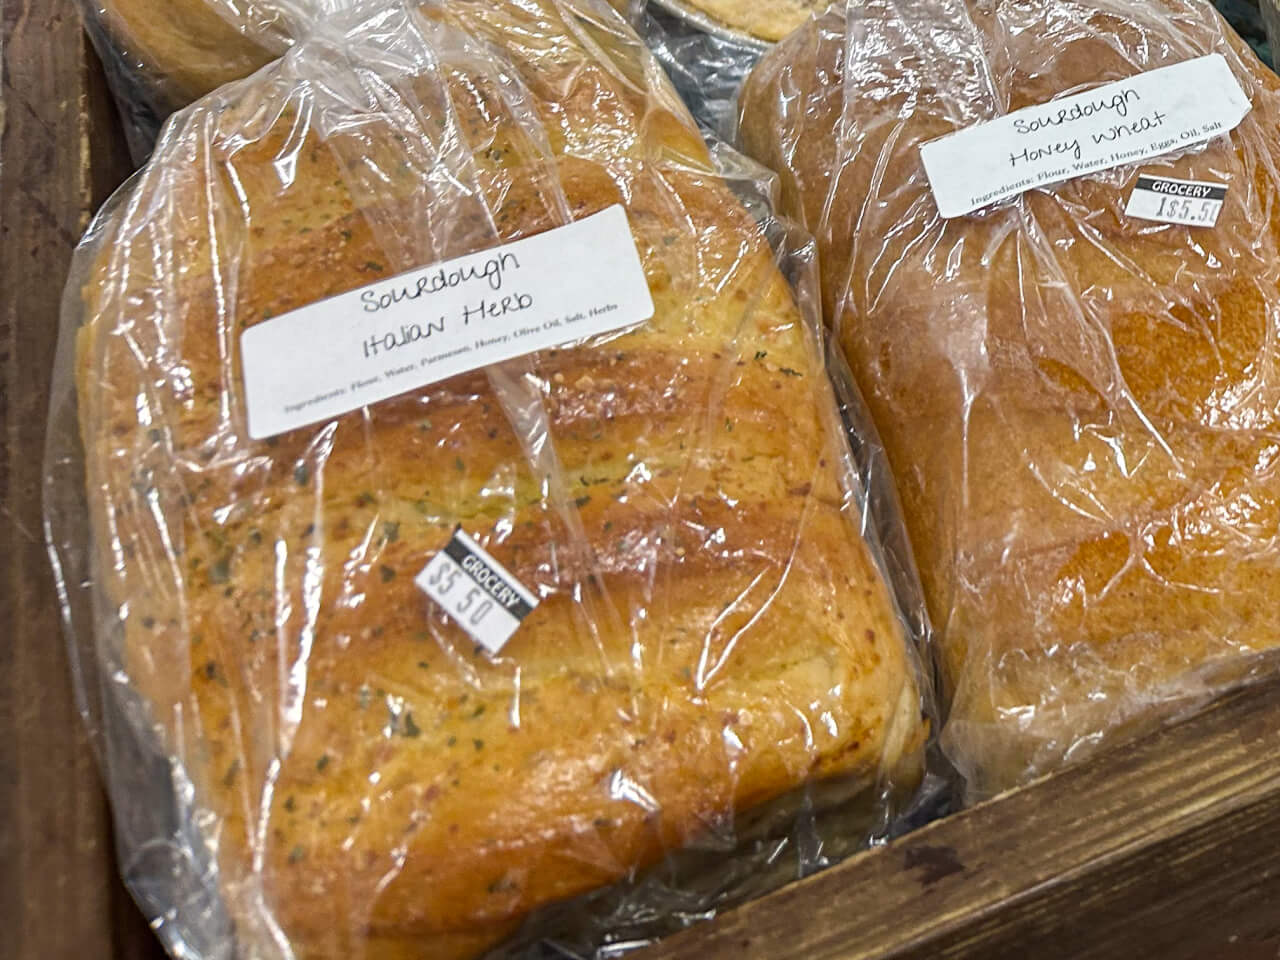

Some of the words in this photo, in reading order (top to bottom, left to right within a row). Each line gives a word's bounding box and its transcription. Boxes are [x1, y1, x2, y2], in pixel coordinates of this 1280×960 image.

[1013, 88, 1141, 136] Sourdough
[969, 176, 1034, 207] Ingredients:
[1037, 166, 1070, 181] Flour,
[1072, 156, 1108, 172] Water,
[1110, 147, 1149, 163] Honey,
[1150, 137, 1177, 152] Eggs,
[1180, 128, 1201, 141] Oil,
[1202, 121, 1223, 135] Salt
[1009, 140, 1081, 168] Honey
[1151, 180, 1212, 198] GROCERY
[360, 249, 521, 313] Sourdough
[363, 316, 445, 358] Italian
[463, 292, 534, 326] Herb
[513, 324, 541, 339] Olive
[462, 554, 522, 608] GROCERY
